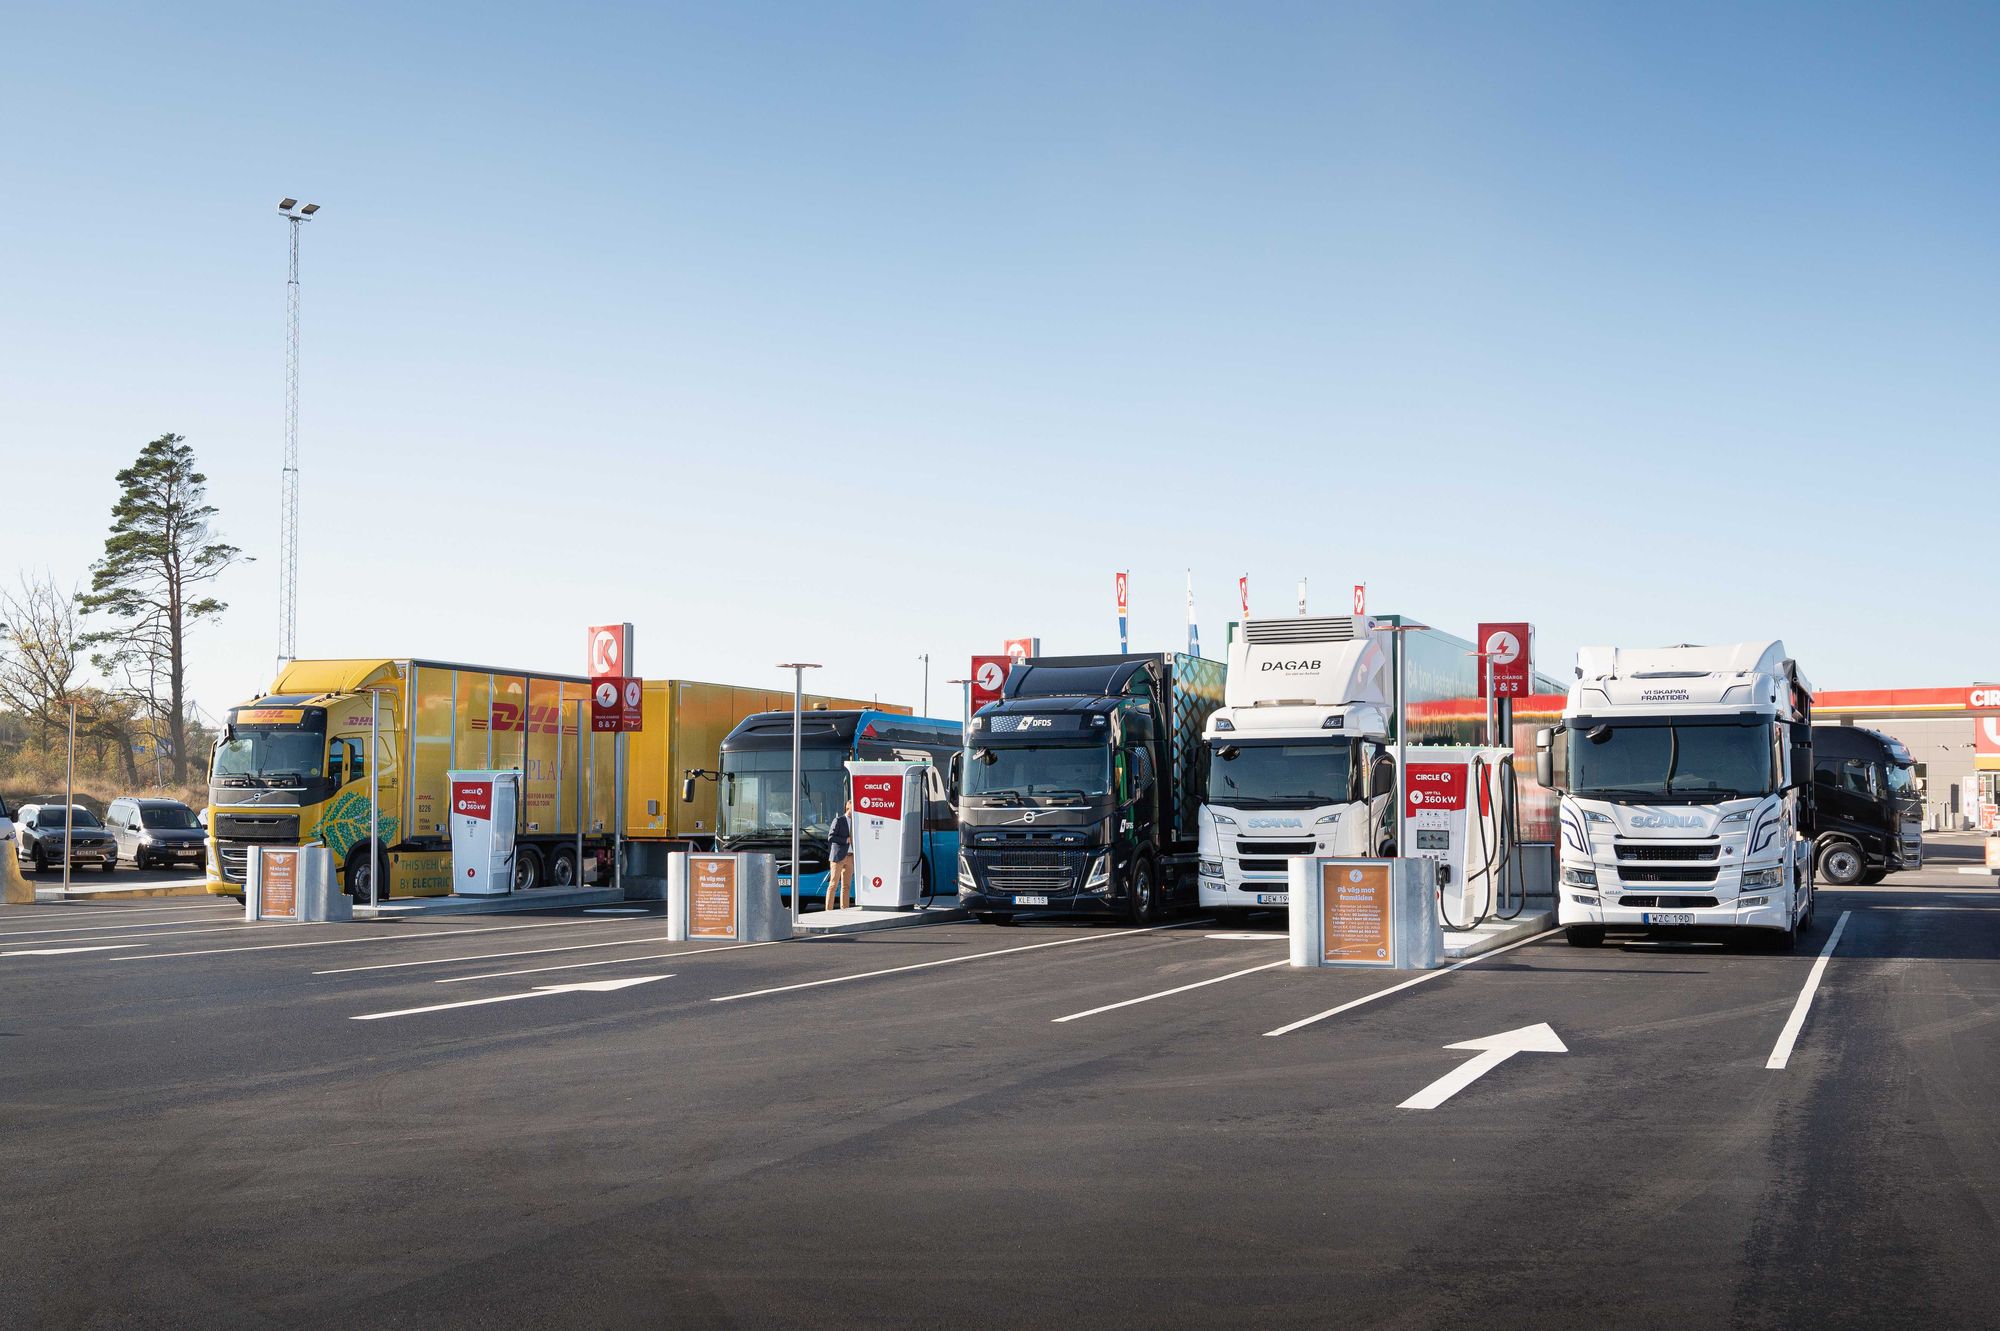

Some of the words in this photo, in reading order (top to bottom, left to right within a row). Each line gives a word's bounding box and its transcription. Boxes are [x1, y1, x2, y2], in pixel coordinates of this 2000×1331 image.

[596, 637, 615, 670] K
[1261, 660, 1321, 671] DAGAB
[1500, 682, 1508, 692] &
[1511, 682, 1518, 692] 3
[1970, 689, 2000, 707] CIR
[256, 710, 284, 718] DHL
[491, 702, 565, 734] DHL
[1032, 719, 1052, 727] DFDS
[1247, 817, 1303, 828] SCANIA
[1630, 815, 1704, 828] SCANIA
[401, 859, 420, 870] THIS
[421, 859, 453, 871] VEHICLE
[400, 878, 410, 889] BY
[412, 877, 449, 889] ELECTRIC
[1651, 914, 1669, 923] WZC
[1673, 914, 1690, 923] 19D
